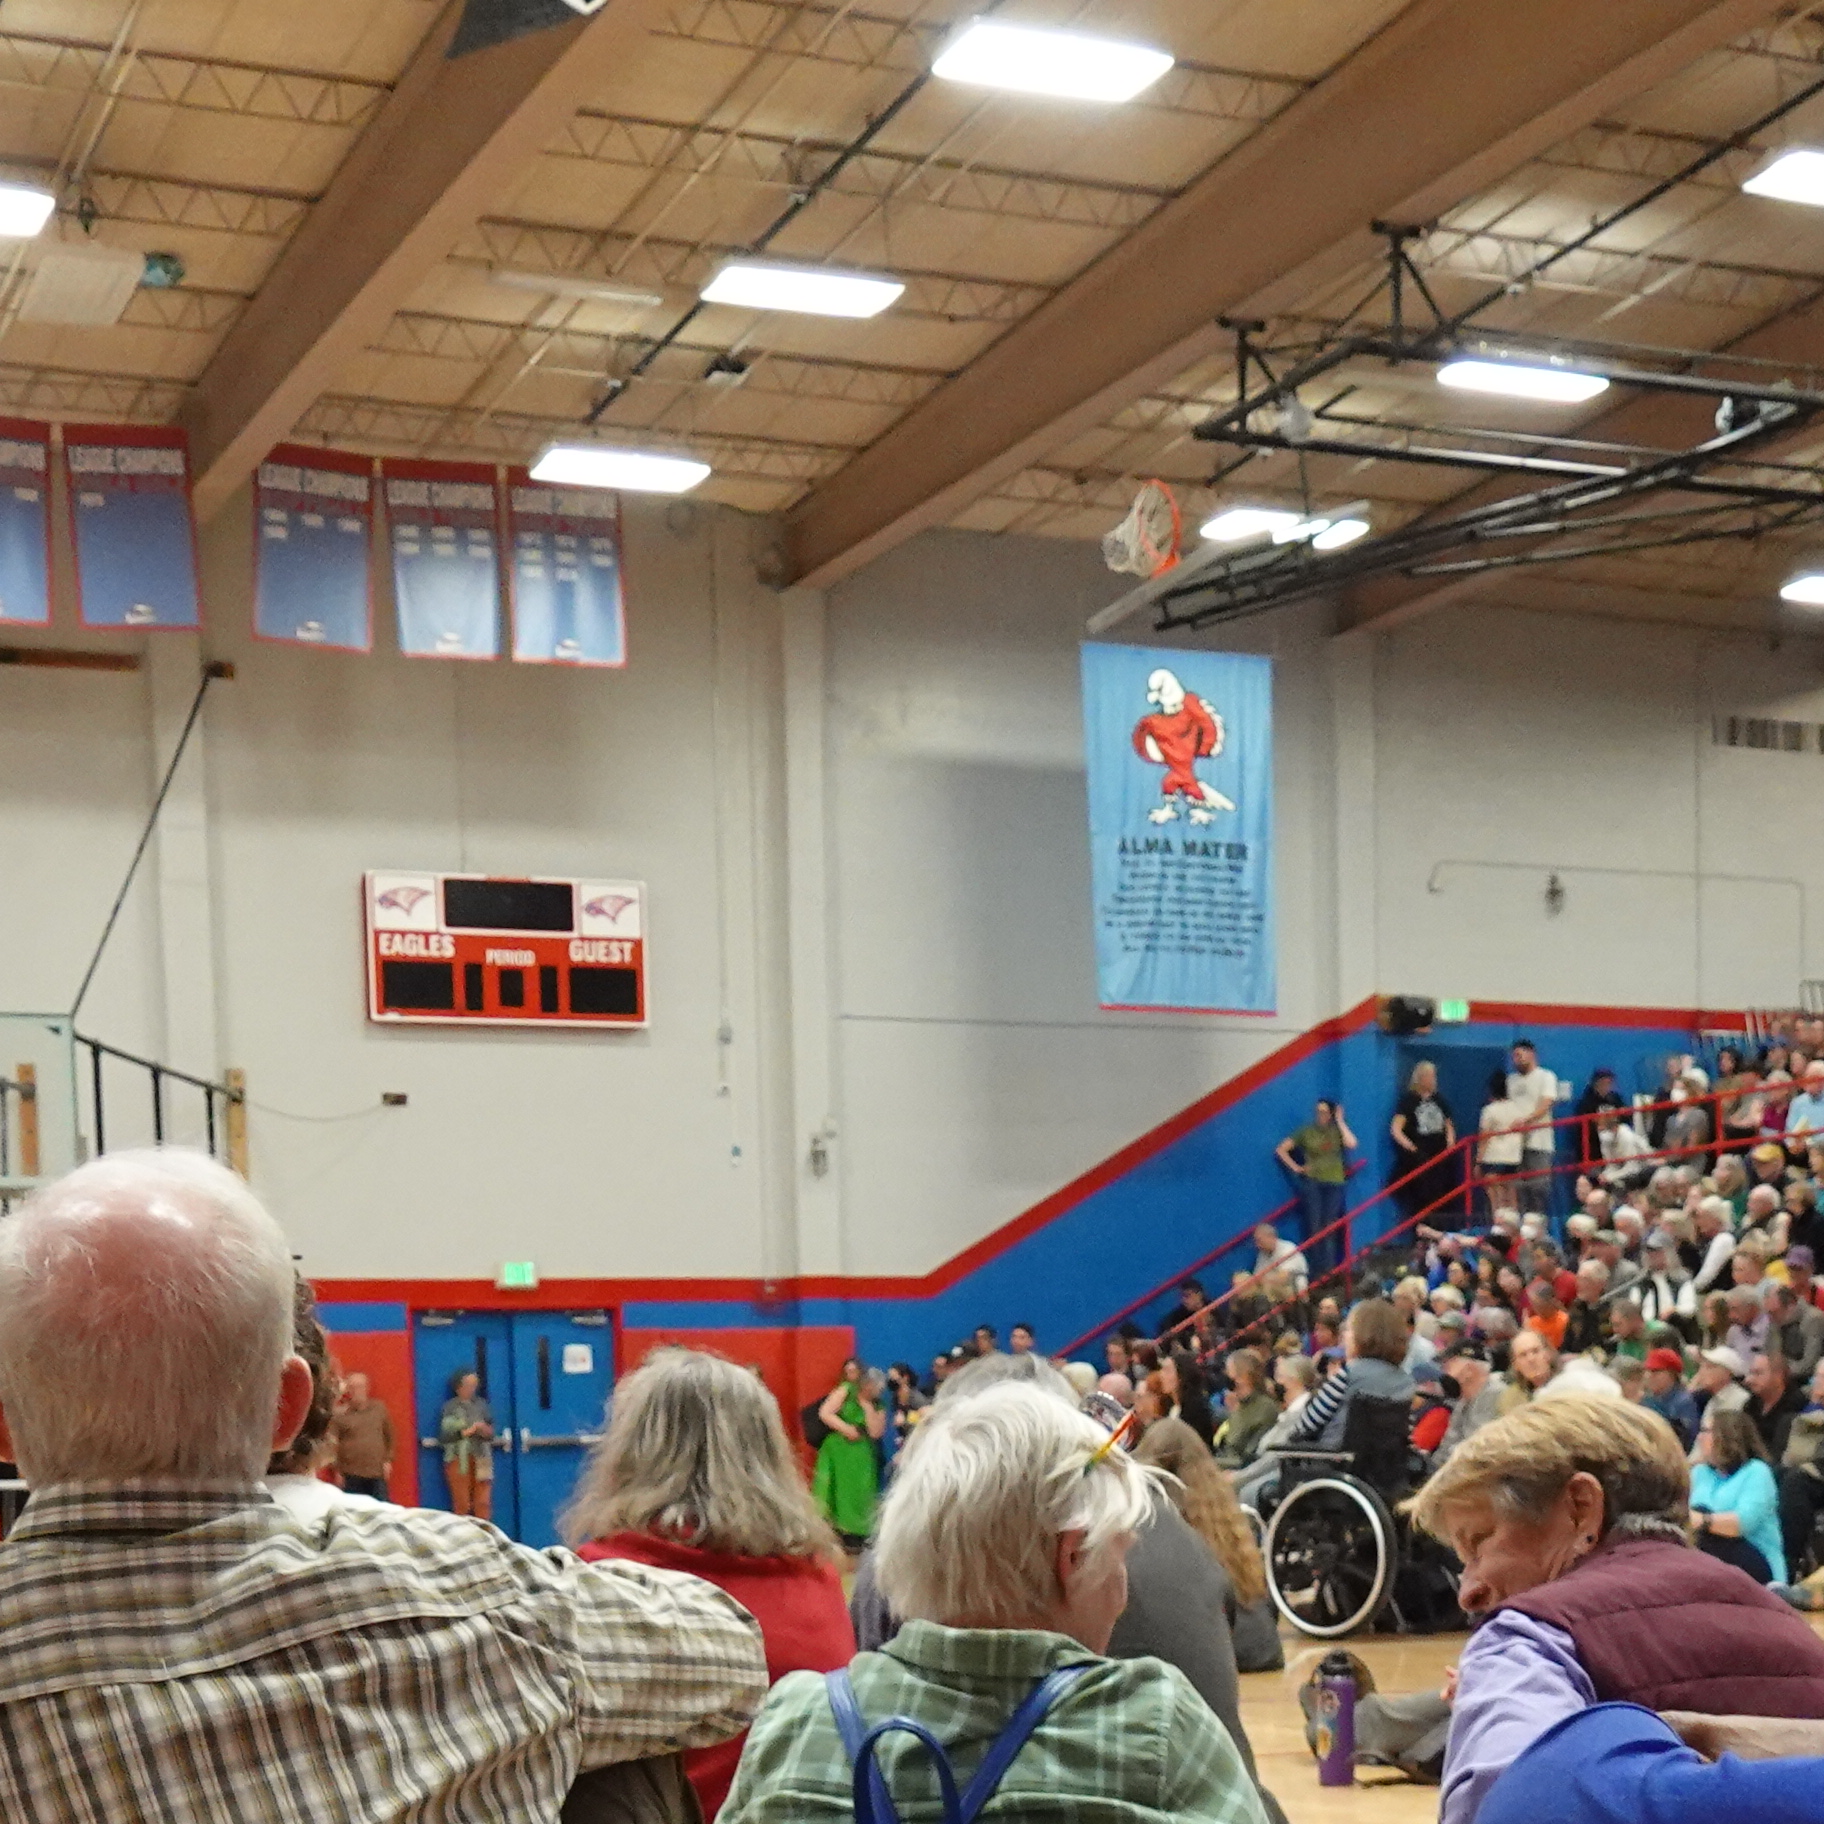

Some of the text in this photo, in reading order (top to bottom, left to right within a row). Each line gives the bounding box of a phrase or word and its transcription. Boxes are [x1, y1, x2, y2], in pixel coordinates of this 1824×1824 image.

[1118, 838, 1247, 860] ALMA MATER
[379, 933, 456, 958] EAGLES
[568, 940, 634, 963] GUEST
